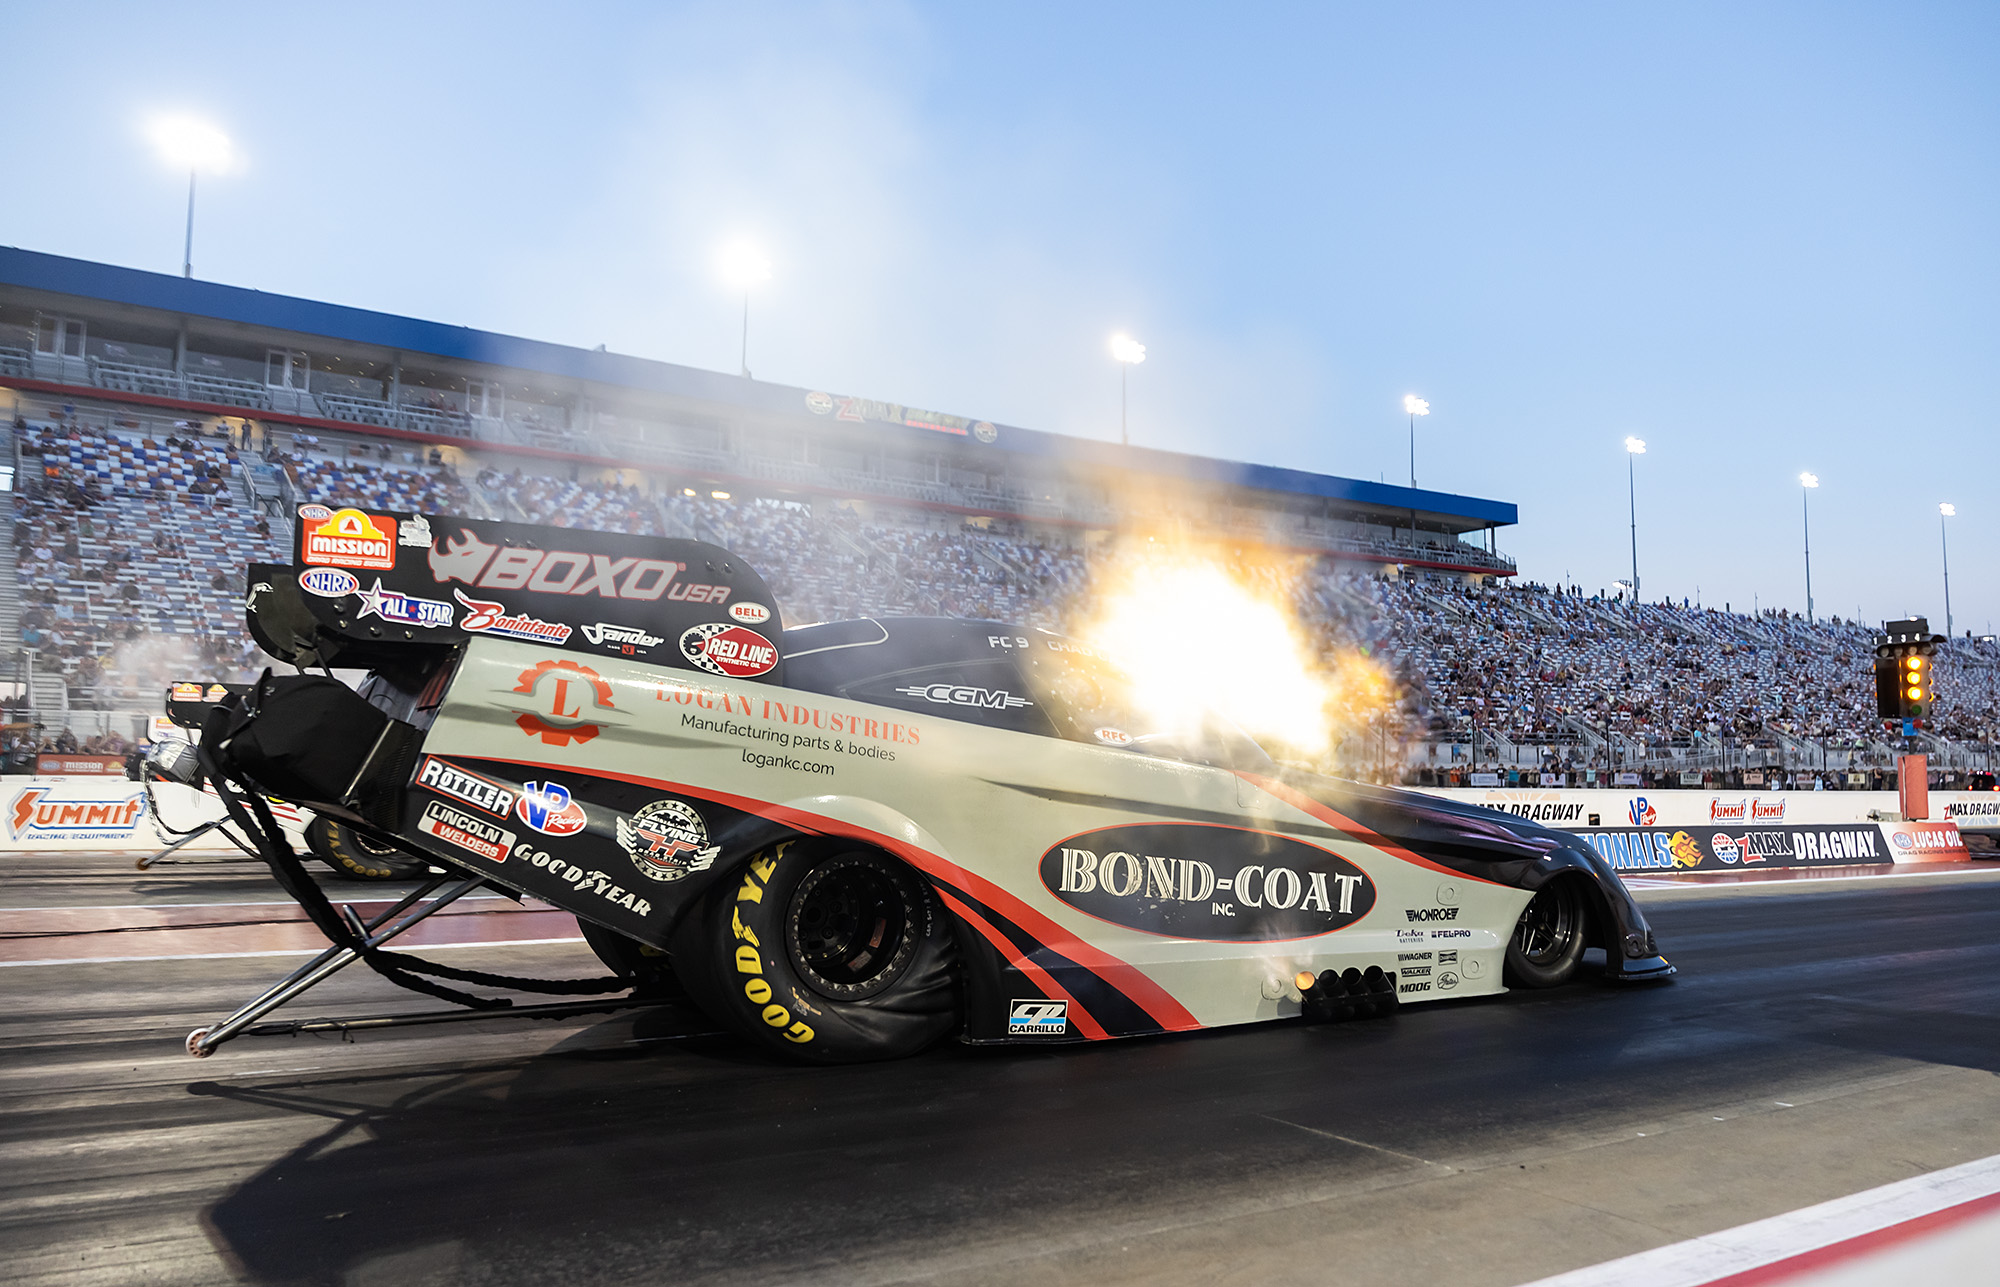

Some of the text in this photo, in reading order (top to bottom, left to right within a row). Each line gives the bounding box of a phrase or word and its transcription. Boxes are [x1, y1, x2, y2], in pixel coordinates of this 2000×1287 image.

[308, 574, 352, 593] NHRA
[474, 547, 731, 604] BOXO USA
[384, 597, 451, 623] ALL STAR
[735, 607, 764, 618] BELL
[988, 635, 1093, 657] FC 9 CHAD
[1887, 635, 1893, 644] 2
[1901, 634, 1906, 643] 3
[1914, 632, 1920, 642] 4
[708, 638, 774, 664] RED LINE
[716, 656, 749, 667] SYNTHETIC
[924, 684, 1009, 709] CGM
[656, 682, 920, 745] LOGAN INDUSTRIES
[681, 713, 896, 762] Manufacturing parts & bodies
[1102, 729, 1126, 742] RFC
[742, 748, 835, 776] logankc.com
[420, 760, 514, 816] ROTTLER
[524, 781, 571, 831] VP
[1510, 804, 1584, 821] DRAGWAY
[1629, 797, 1648, 825] VP
[1969, 803, 2000, 816] DRAGW
[430, 805, 500, 843] LINCOLN
[547, 814, 585, 830] Racing
[638, 818, 701, 844] FLYING
[440, 825, 499, 857] WELDERS
[1912, 831, 1945, 848] LUCAS
[1945, 830, 1963, 848] OIL
[514, 843, 652, 917] GOODYEAR
[1059, 848, 1363, 914] BOND-COAT
[1211, 902, 1236, 917] INC.
[1412, 908, 1453, 922] MONROE
[1404, 952, 1432, 961] WAGNER
[1402, 967, 1431, 976] WALKER
[1400, 982, 1431, 993] MOOG
[1010, 1025, 1064, 1033] CARRILLO
